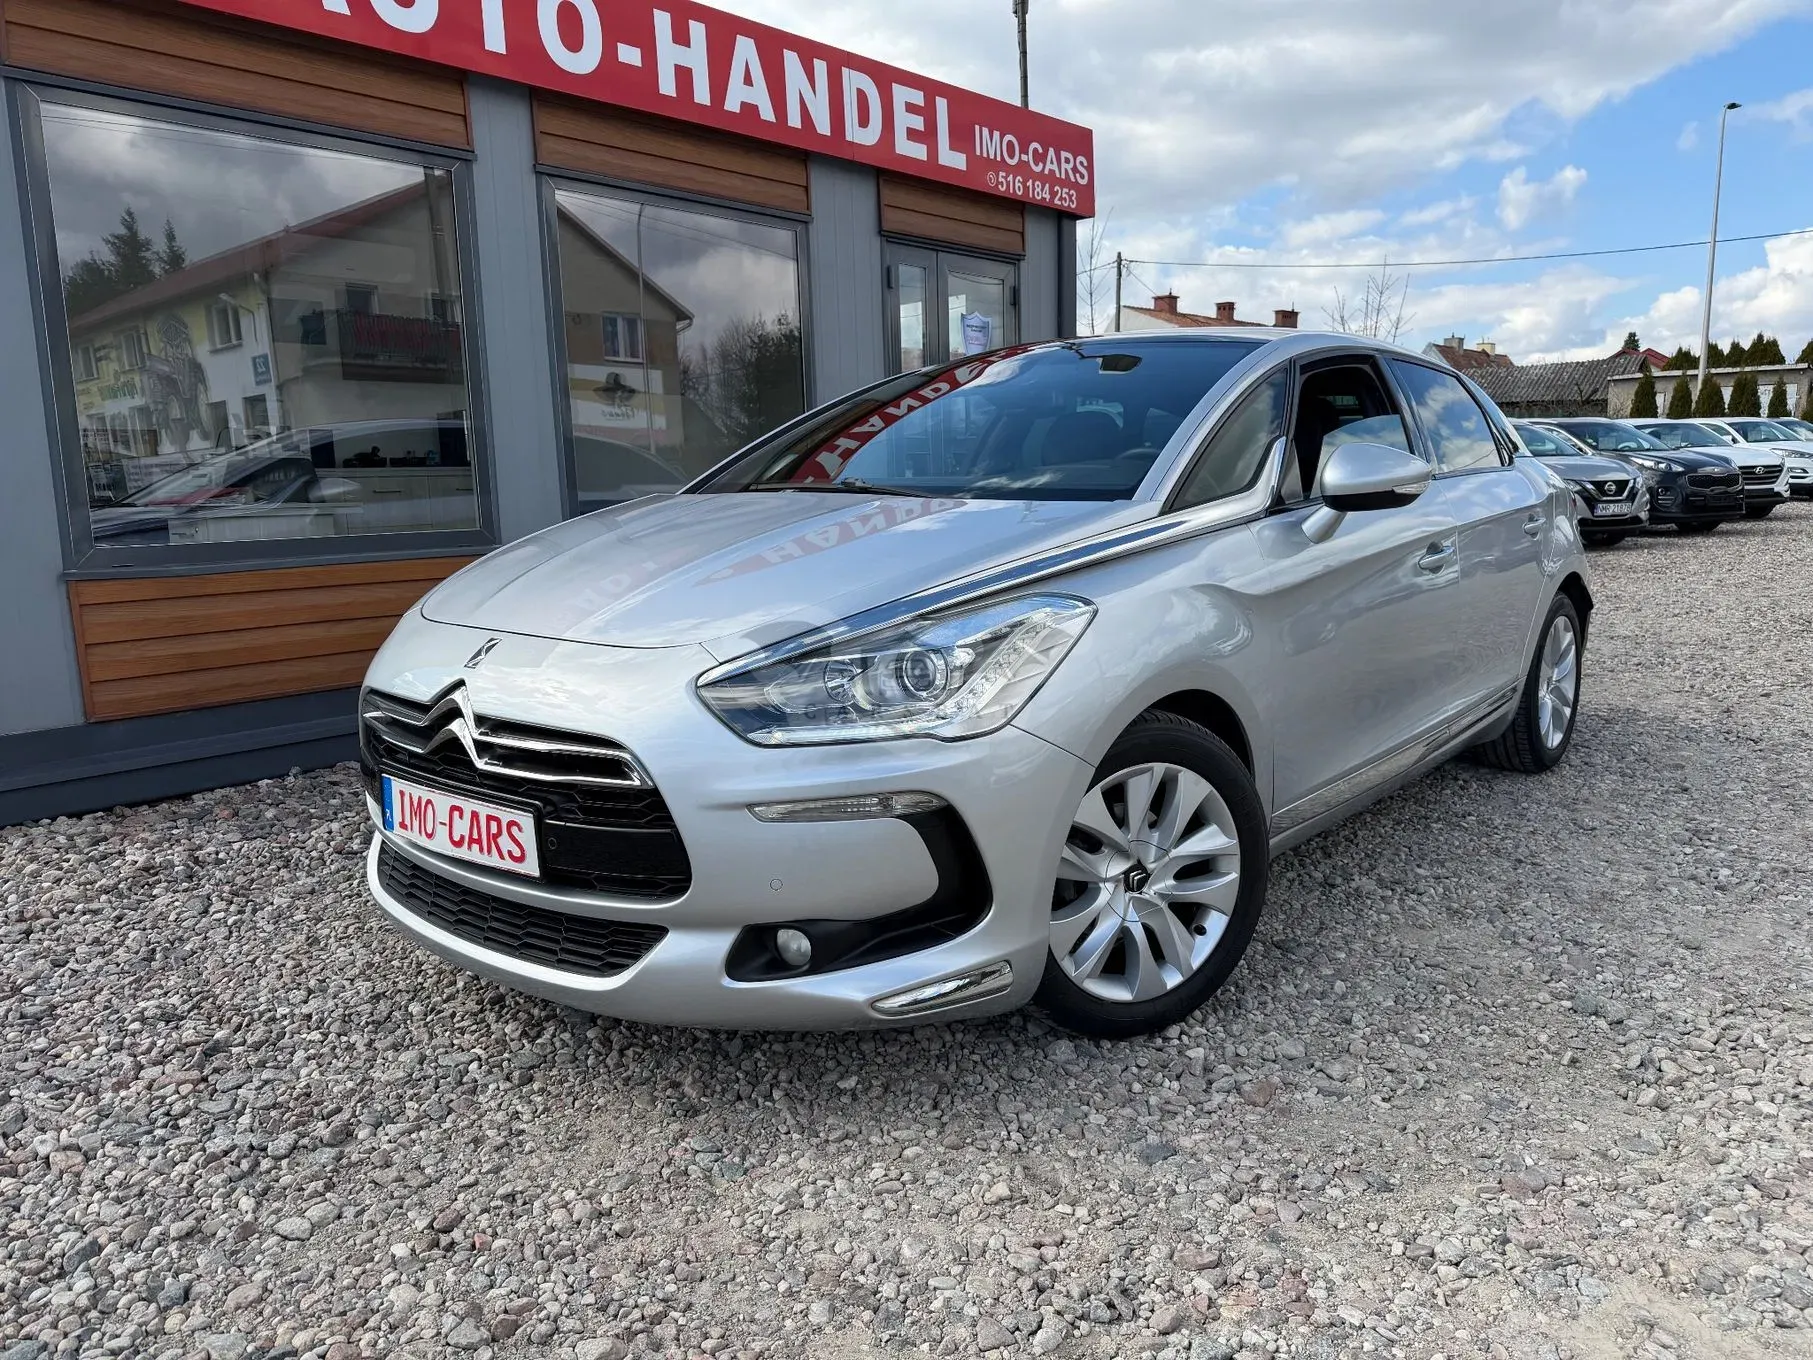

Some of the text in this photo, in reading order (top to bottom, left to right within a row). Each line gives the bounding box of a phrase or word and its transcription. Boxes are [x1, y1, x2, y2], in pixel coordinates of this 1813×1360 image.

[321, 0, 967, 171] O-HANDEL
[975, 124, 1089, 185] IMO-CARS
[998, 171, 1077, 209] 516 184 253
[398, 789, 527, 864] IMO-CARS
